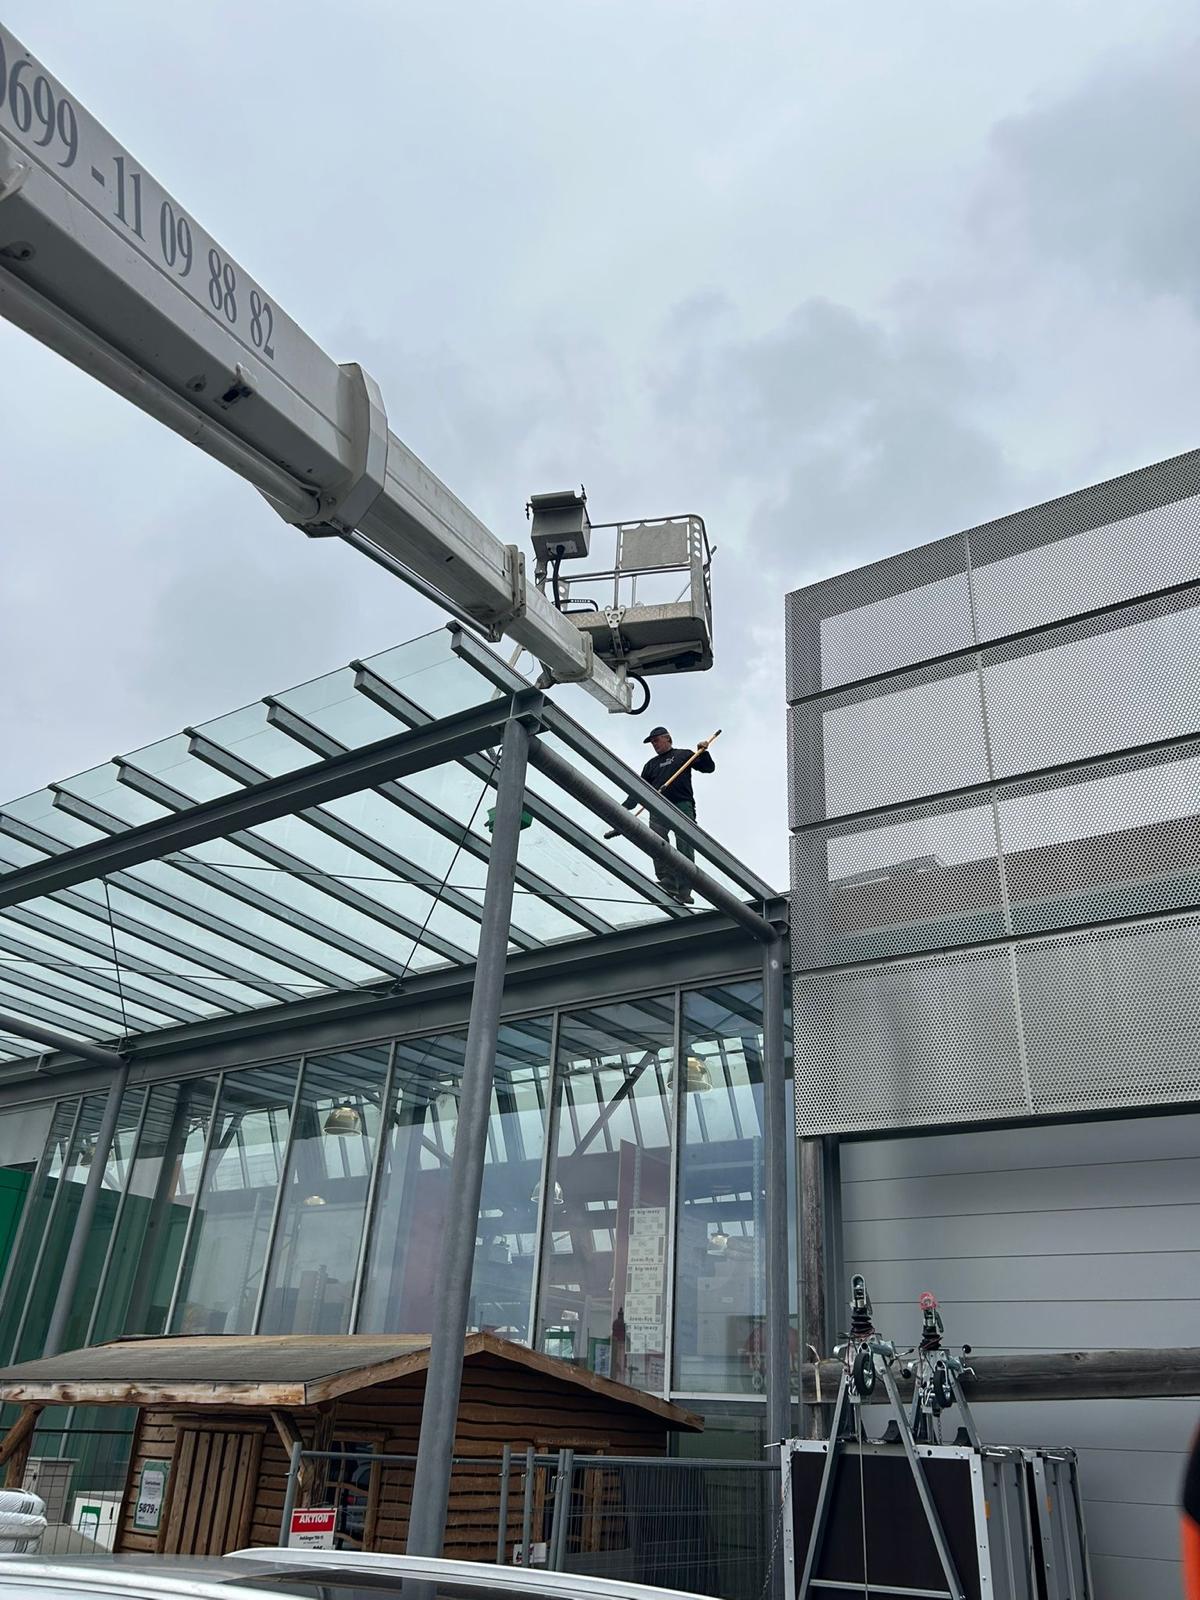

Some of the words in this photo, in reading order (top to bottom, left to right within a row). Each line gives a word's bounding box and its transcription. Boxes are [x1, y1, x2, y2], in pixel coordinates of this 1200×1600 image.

[0, 35, 78, 168] 699
[160, 201, 193, 278] 09
[208, 248, 237, 324] 88
[250, 290, 275, 360] 82
[298, 1513, 329, 1524] AKTION
